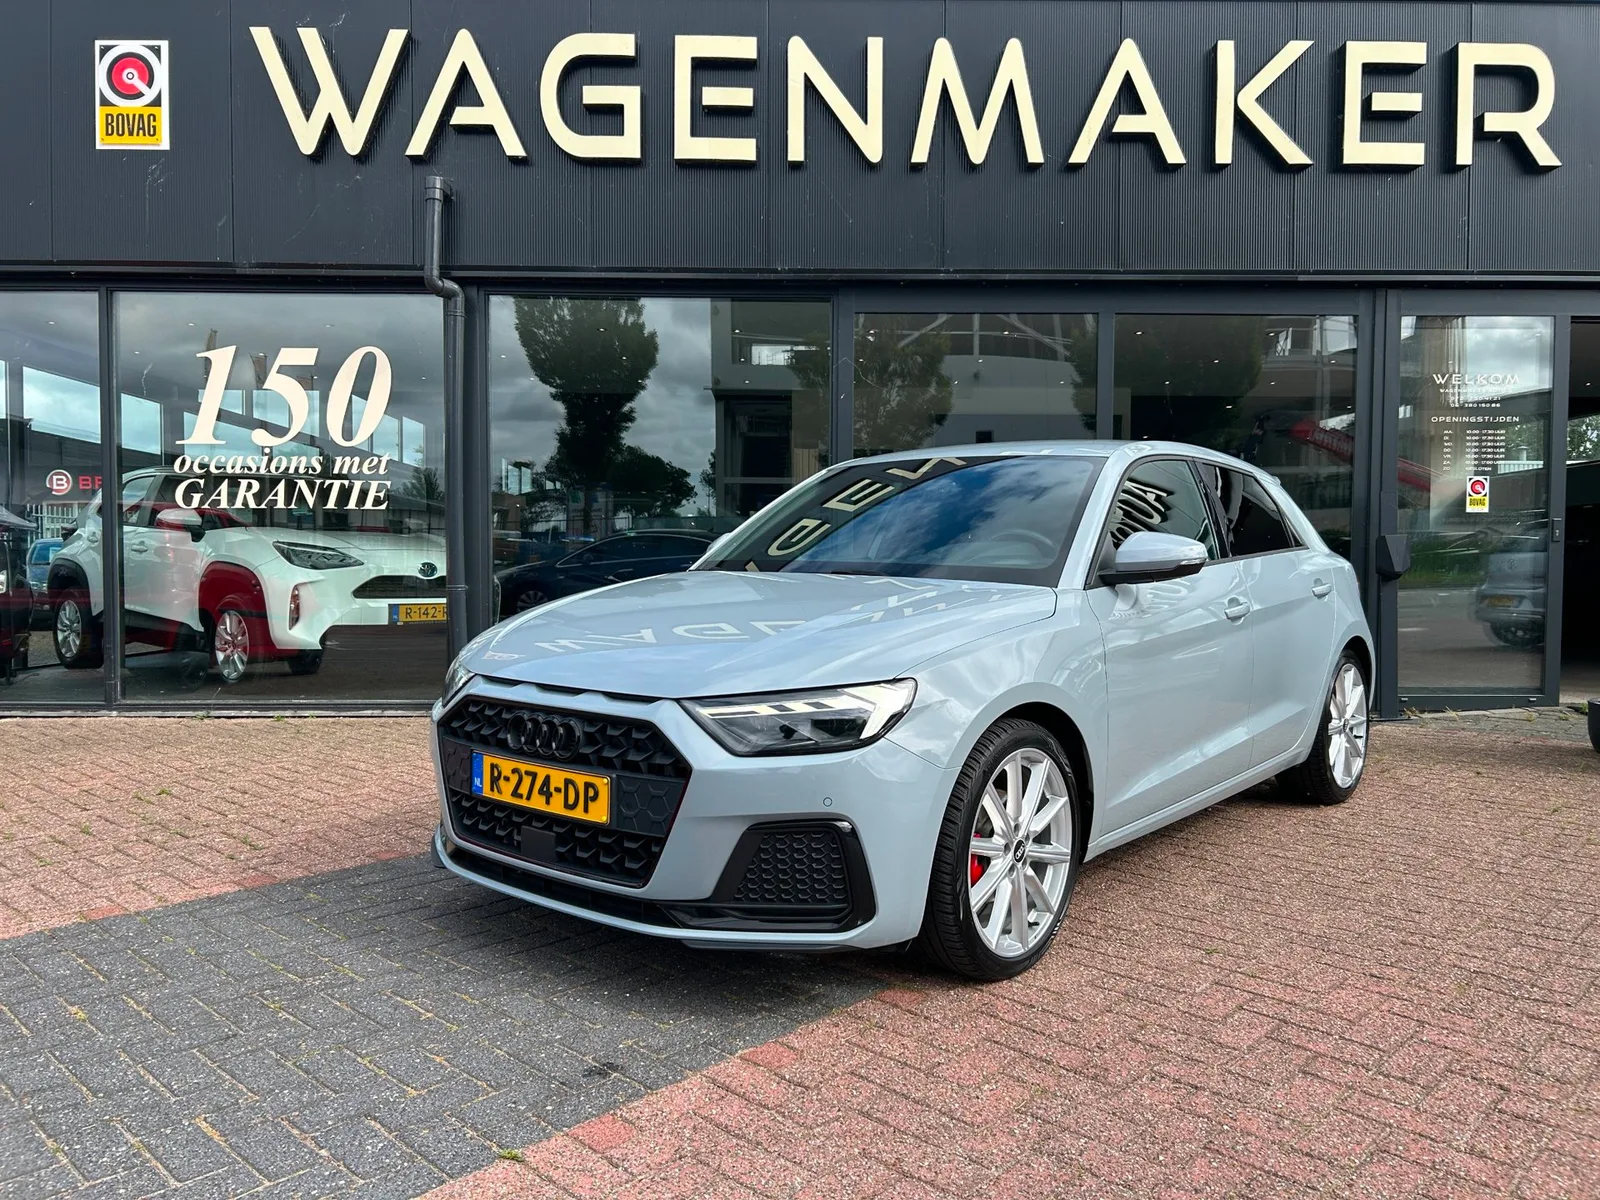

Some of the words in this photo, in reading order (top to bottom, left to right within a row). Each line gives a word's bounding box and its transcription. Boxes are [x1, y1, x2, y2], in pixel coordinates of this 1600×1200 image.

[249, 27, 1562, 167] WAGENMAKER
[105, 113, 157, 137] BOVAG
[1432, 373, 1520, 385] WELKOM
[175, 345, 392, 447] 150
[173, 448, 323, 475] occasions
[333, 452, 393, 475] met
[174, 478, 393, 510] GARANTIE
[1469, 497, 1486, 507] BOVAG
[474, 777, 482, 787] NL
[490, 762, 599, 814] R-274-DP
